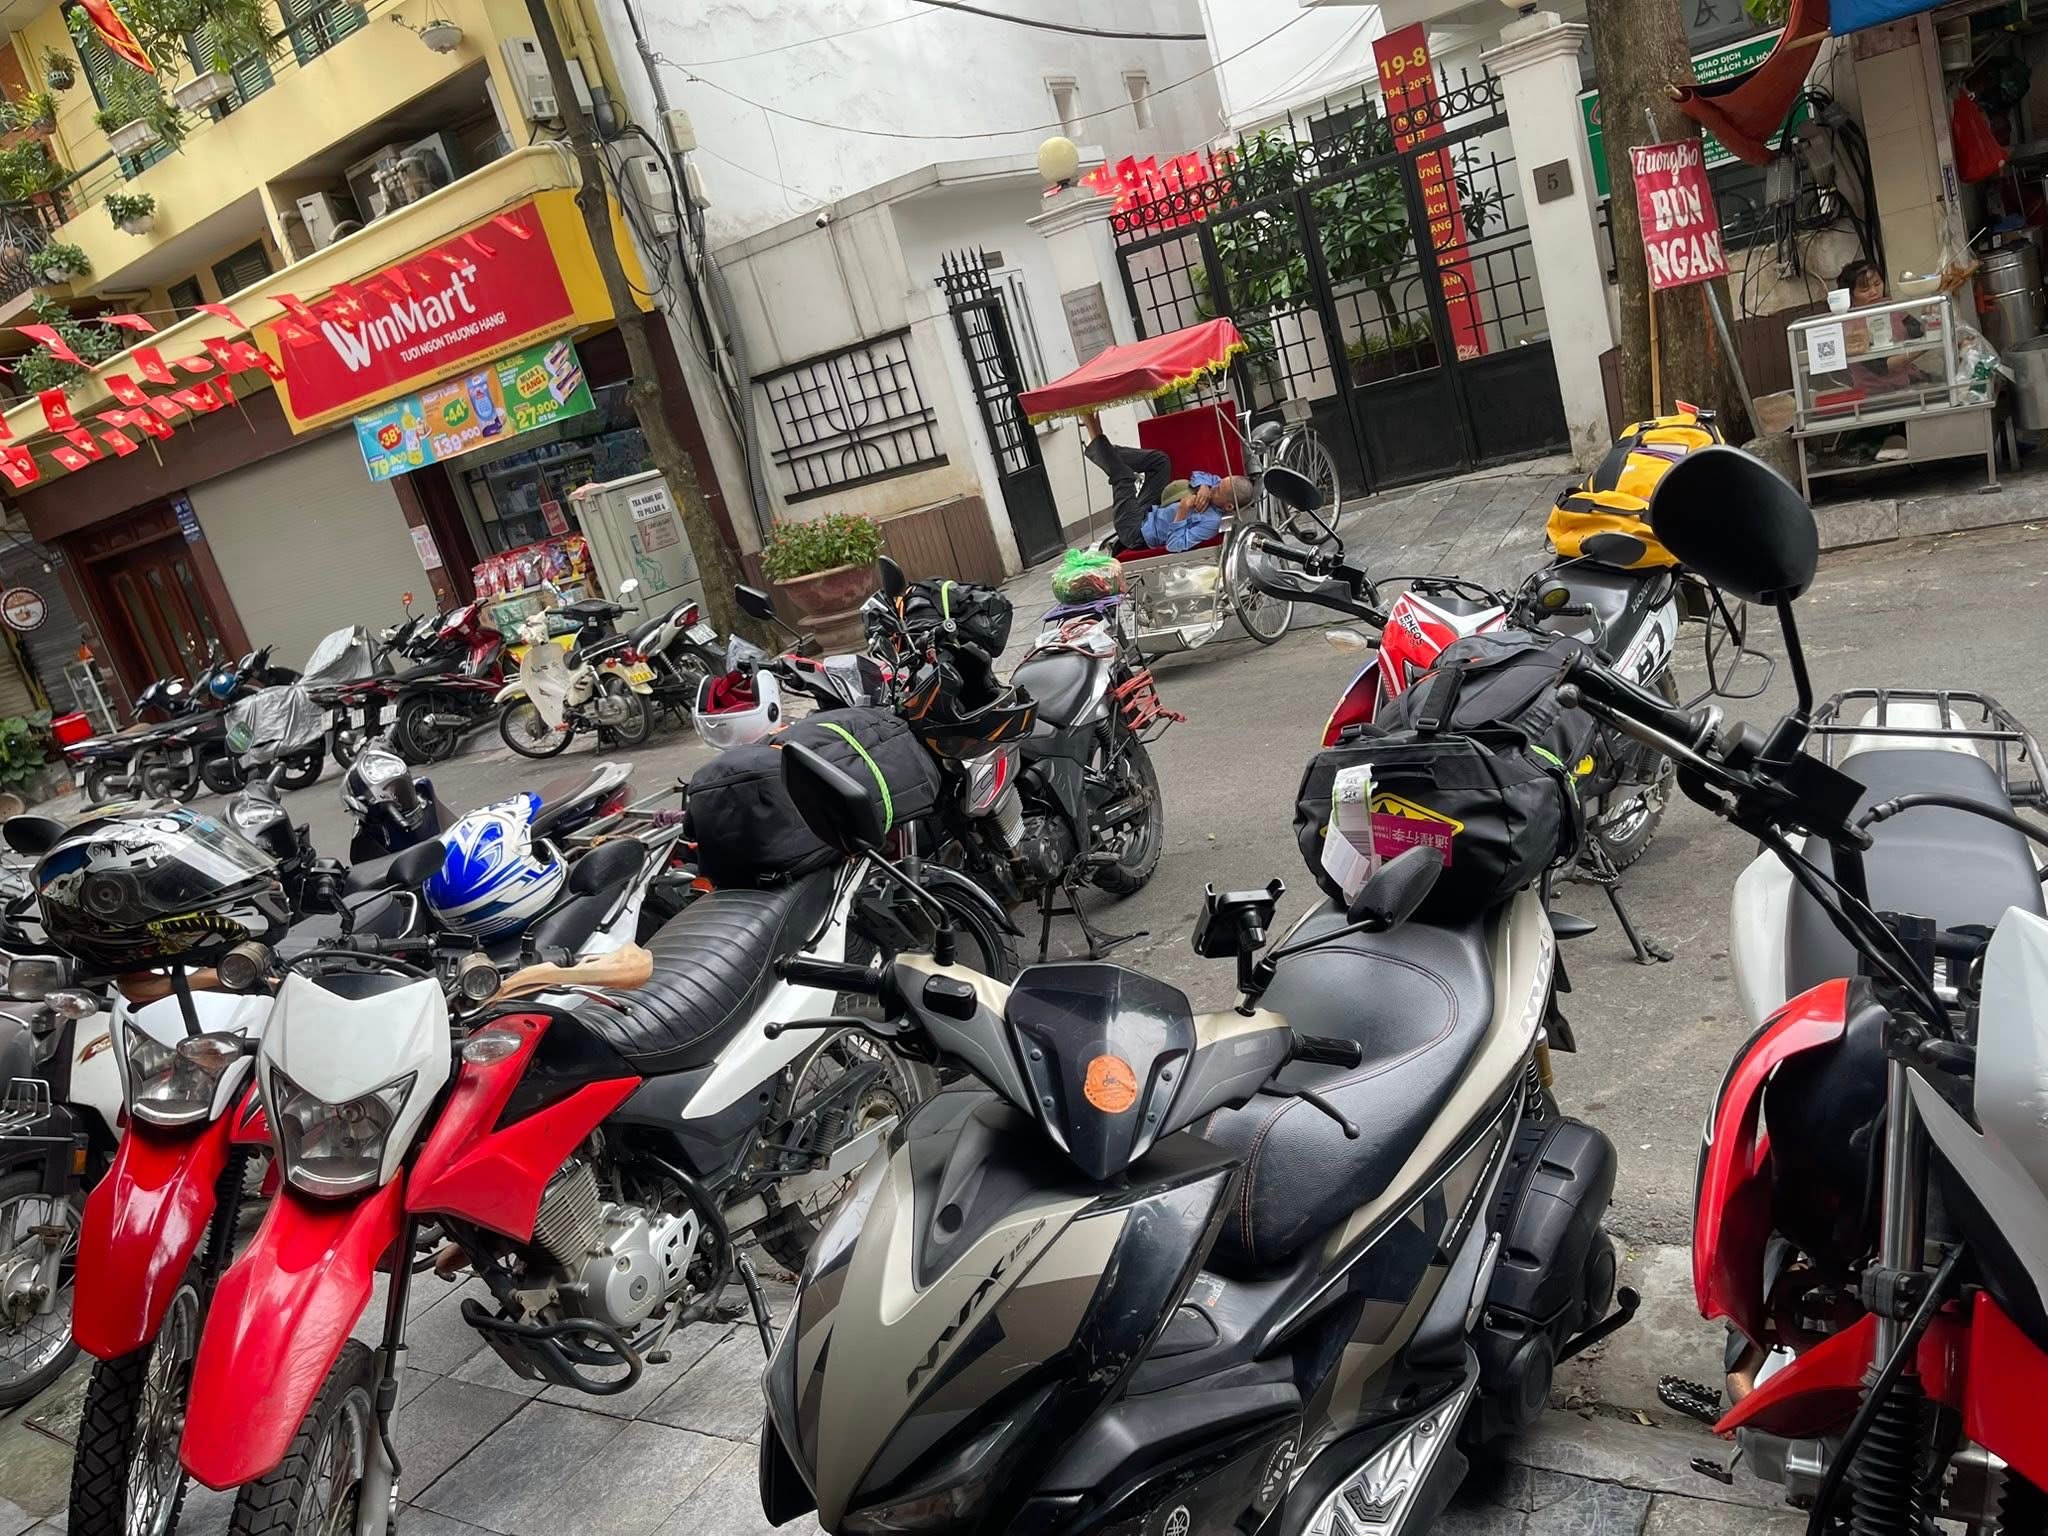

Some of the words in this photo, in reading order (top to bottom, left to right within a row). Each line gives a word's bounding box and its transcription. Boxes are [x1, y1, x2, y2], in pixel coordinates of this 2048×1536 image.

[1379, 47, 1427, 79] 19-8
[1697, 59, 1719, 71] GIAO
[1721, 51, 1741, 64] DỊCH
[1718, 60, 1741, 74] SÁCH
[1418, 163, 1441, 180] ỪNG
[1548, 172, 1559, 190] 5
[1427, 201, 1448, 216] ÁCH
[1650, 175, 1705, 232] BÚN
[1430, 221, 1452, 237] ẠNG
[1648, 230, 1724, 284] NGAN
[421, 336, 444, 357] NGON
[1631, 576, 1658, 614] HOND
[1403, 613, 1425, 645] ENEOS
[1391, 828, 1449, 849] 通程行李
[1446, 1199, 1473, 1248] LIQUID
[1472, 1139, 1501, 1198] COOLED
[907, 1256, 1007, 1395] NVX
[1010, 1216, 1047, 1263] 155
